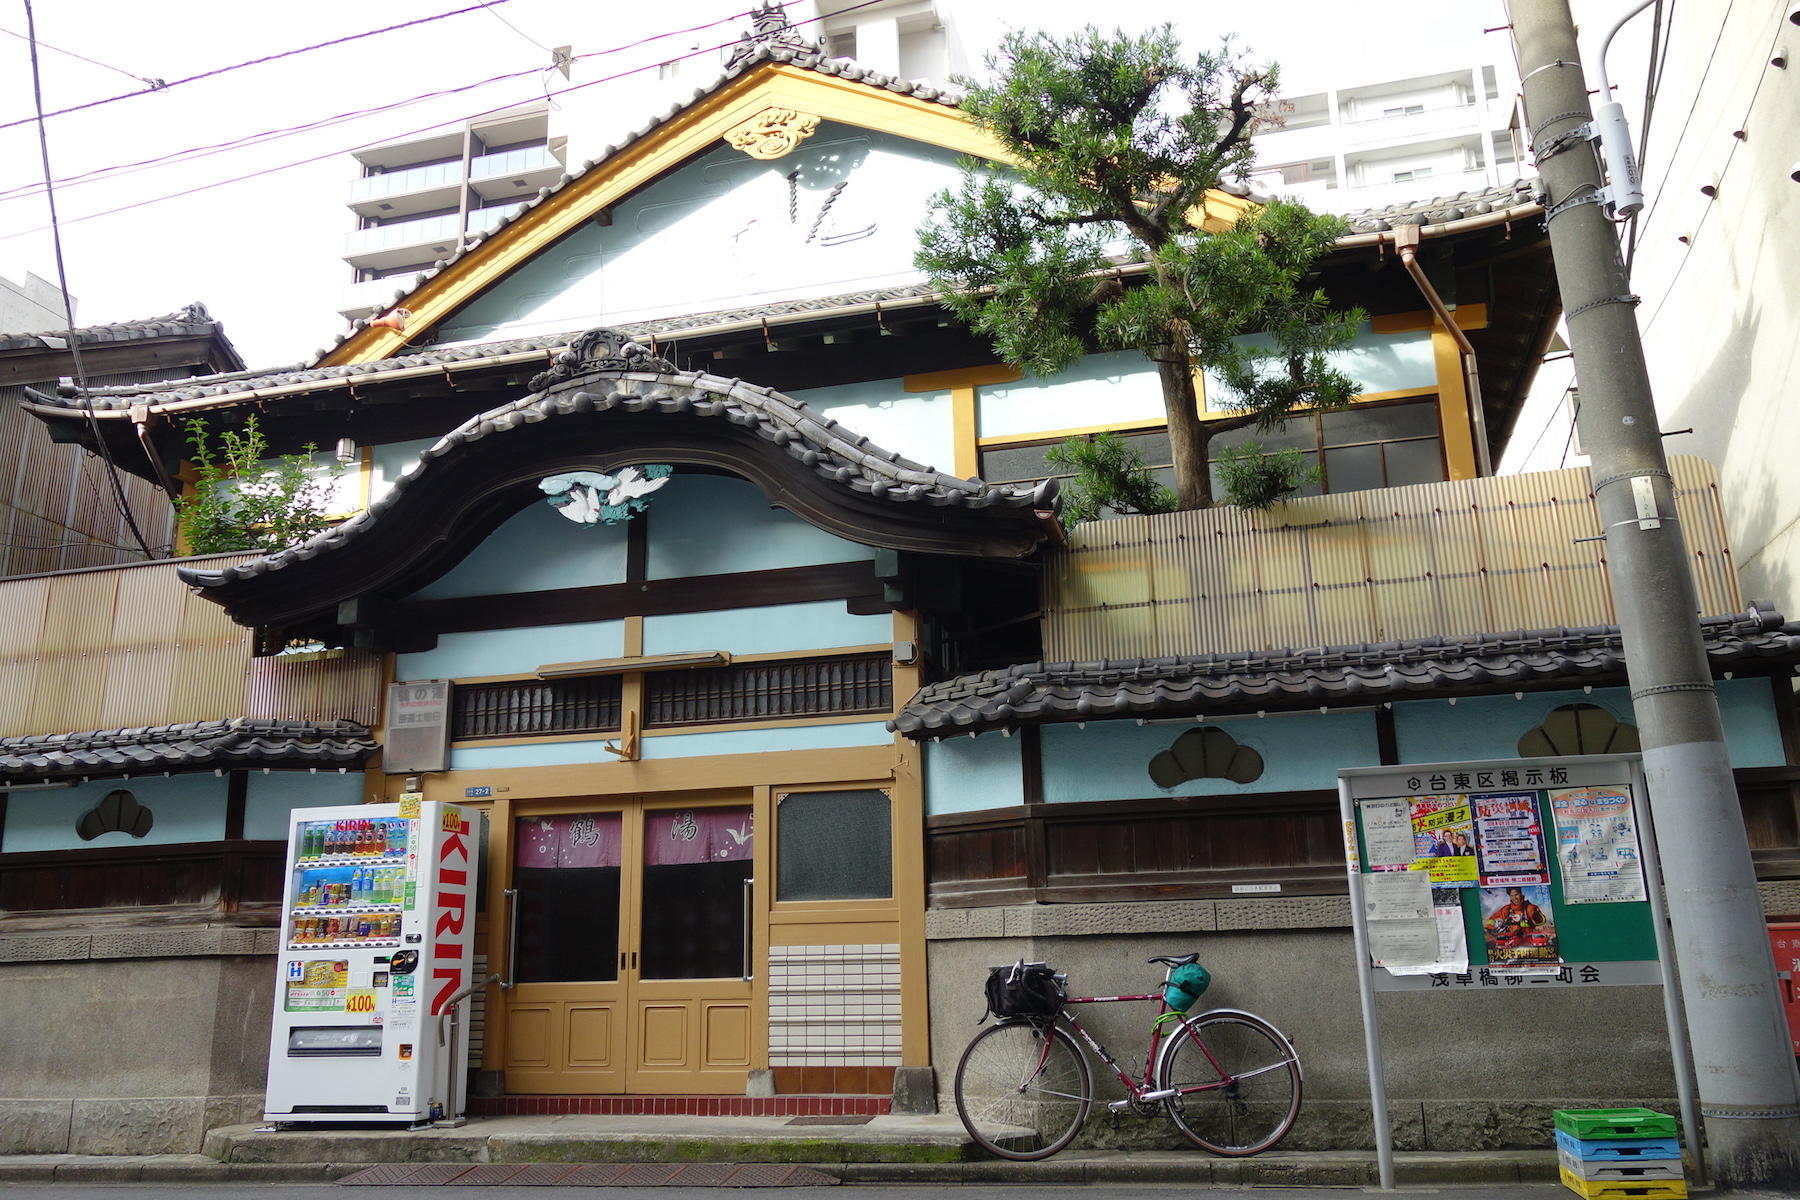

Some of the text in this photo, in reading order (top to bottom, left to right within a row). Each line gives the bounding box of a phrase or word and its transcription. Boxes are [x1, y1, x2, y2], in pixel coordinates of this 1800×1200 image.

[1429, 768, 1569, 791] 台東区掲示板
[570, 811, 698, 848] 鶴 湯
[431, 820, 470, 1016] KIRIN
[1430, 965, 1601, 987] 浅草橋柳二町会
